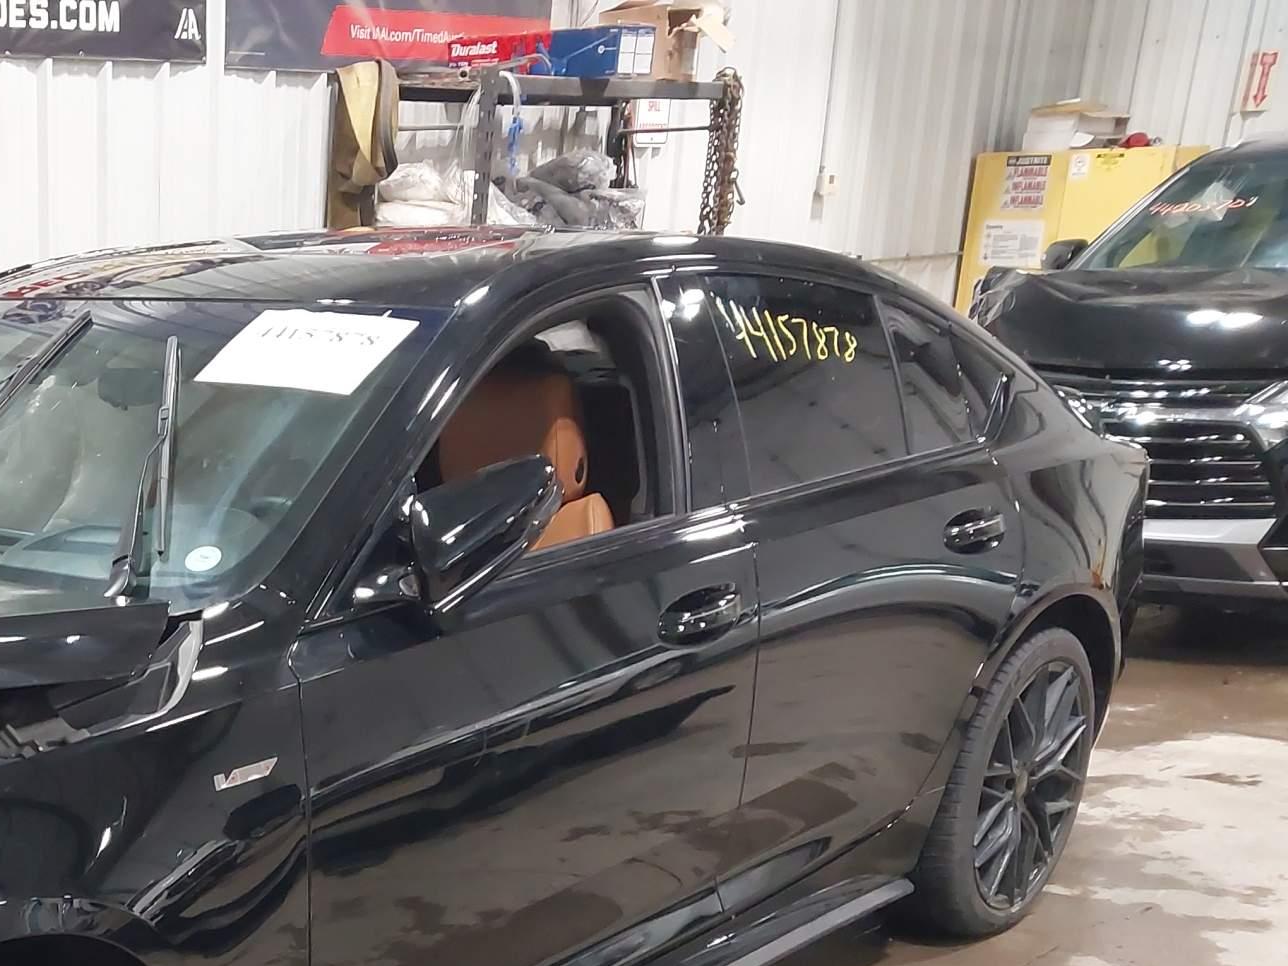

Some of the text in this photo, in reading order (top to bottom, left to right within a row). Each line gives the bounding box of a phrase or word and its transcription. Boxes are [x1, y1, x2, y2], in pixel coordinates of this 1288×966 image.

[350, 24, 370, 40] Visit
[451, 40, 498, 57] Duralast
[710, 292, 858, 362] 44157878
